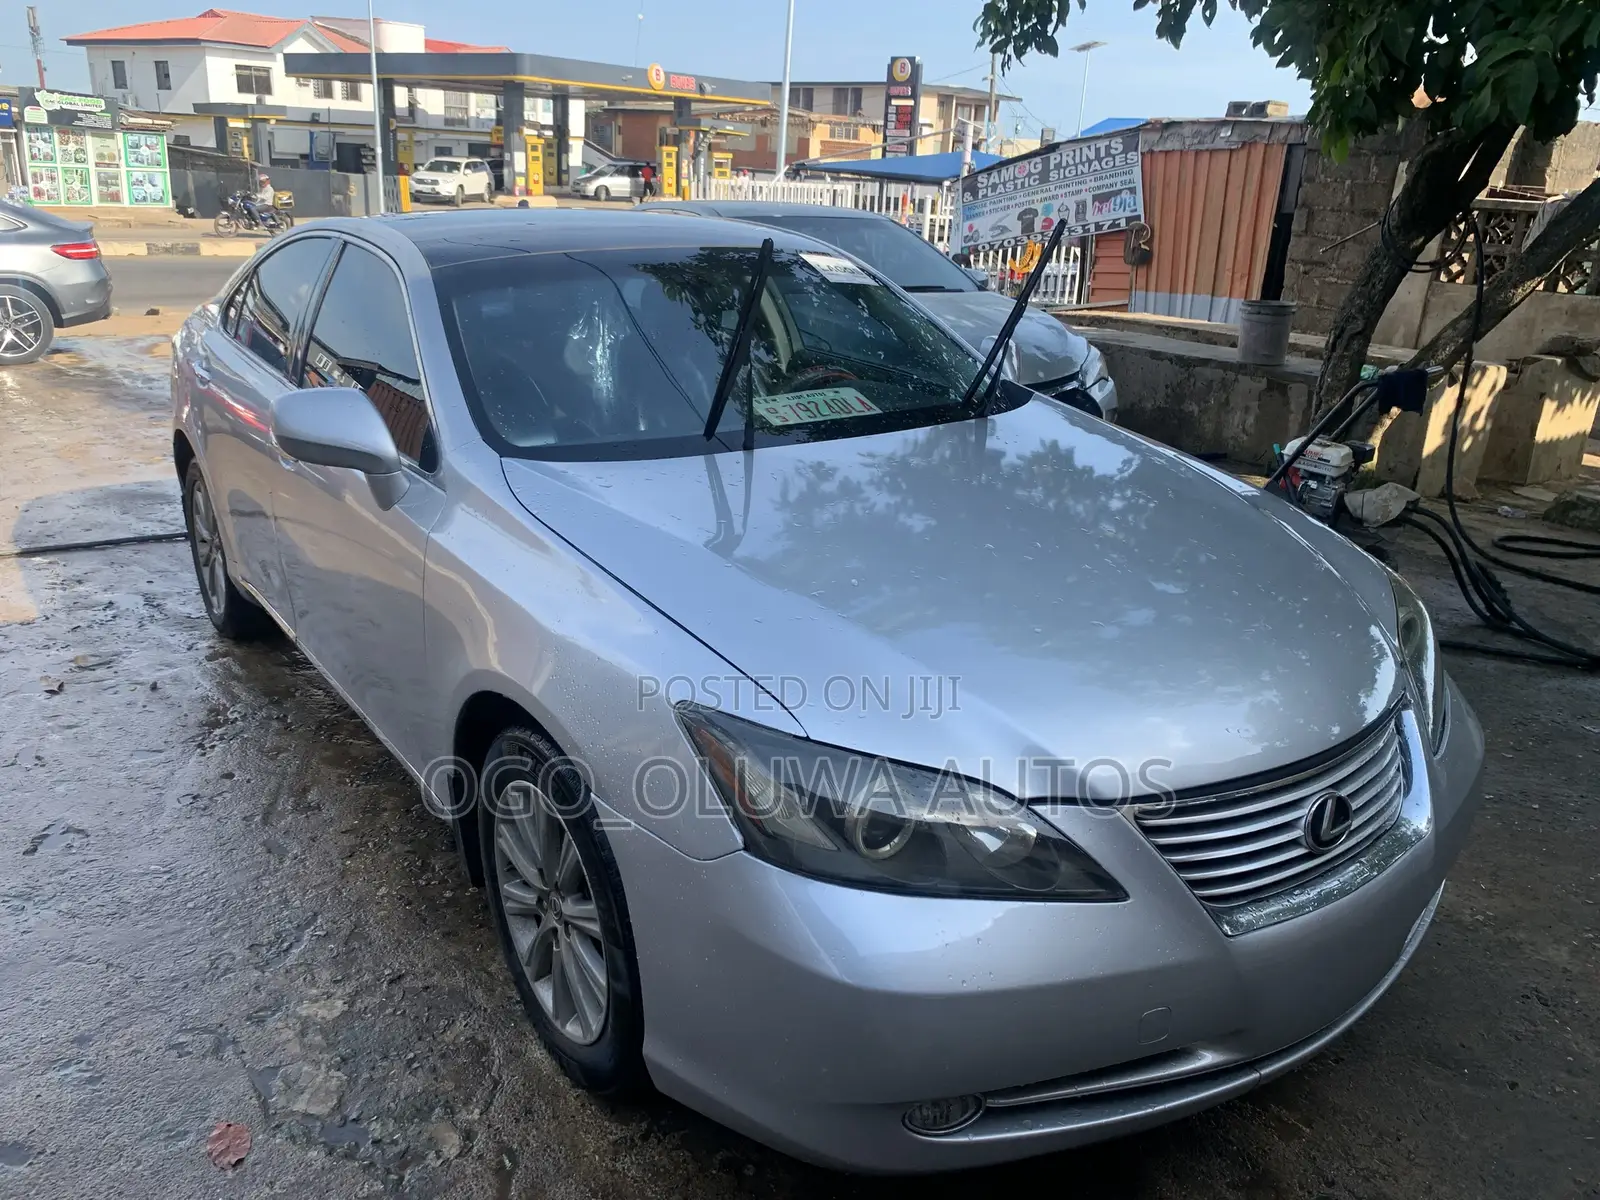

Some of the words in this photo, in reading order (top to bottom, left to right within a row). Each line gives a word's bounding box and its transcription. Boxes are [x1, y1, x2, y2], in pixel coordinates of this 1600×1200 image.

[963, 191, 973, 204] &
[978, 174, 1040, 200] PLASTIC
[1049, 151, 1139, 182] SIGNAGES
[977, 157, 1042, 188] SAMOG
[1051, 138, 1123, 169] PRINTS
[988, 204, 1011, 215] STICKER
[1014, 199, 1035, 209] POSTER
[1040, 193, 1060, 204] AWARD
[1063, 188, 1084, 199] STAMP
[1088, 182, 1118, 193] COMPANY
[1120, 178, 1136, 187] SEAL
[989, 195, 1017, 206] PAINTING
[1022, 188, 1052, 198] GENERAL
[1054, 179, 1088, 191] PRINTING
[1093, 169, 1134, 182] BRANDING
